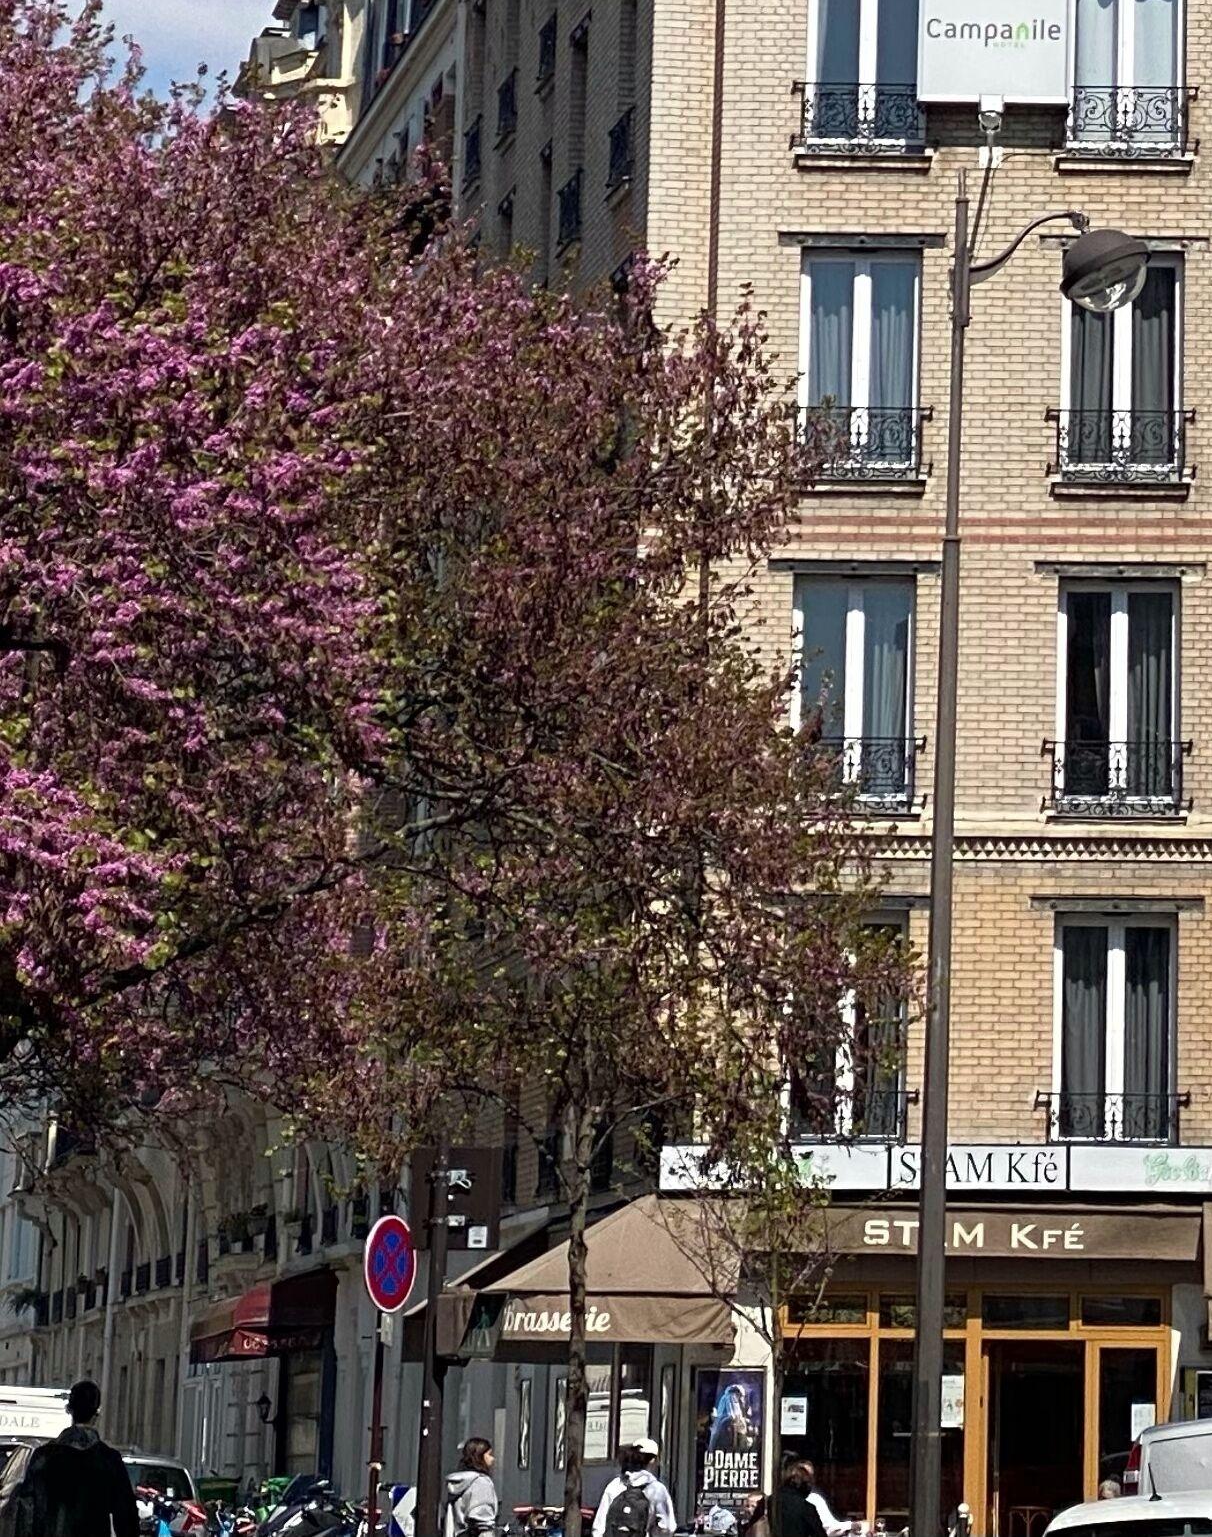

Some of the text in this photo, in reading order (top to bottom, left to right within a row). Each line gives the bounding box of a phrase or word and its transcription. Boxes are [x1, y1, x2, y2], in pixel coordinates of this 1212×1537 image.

[926, 18, 1062, 47] Campanile
[900, 1151, 1058, 1184] SAM Kfé
[863, 1220, 985, 1249] STM
[704, 1449, 759, 1470] LA DAME
[702, 1465, 760, 1491] PIERRE
